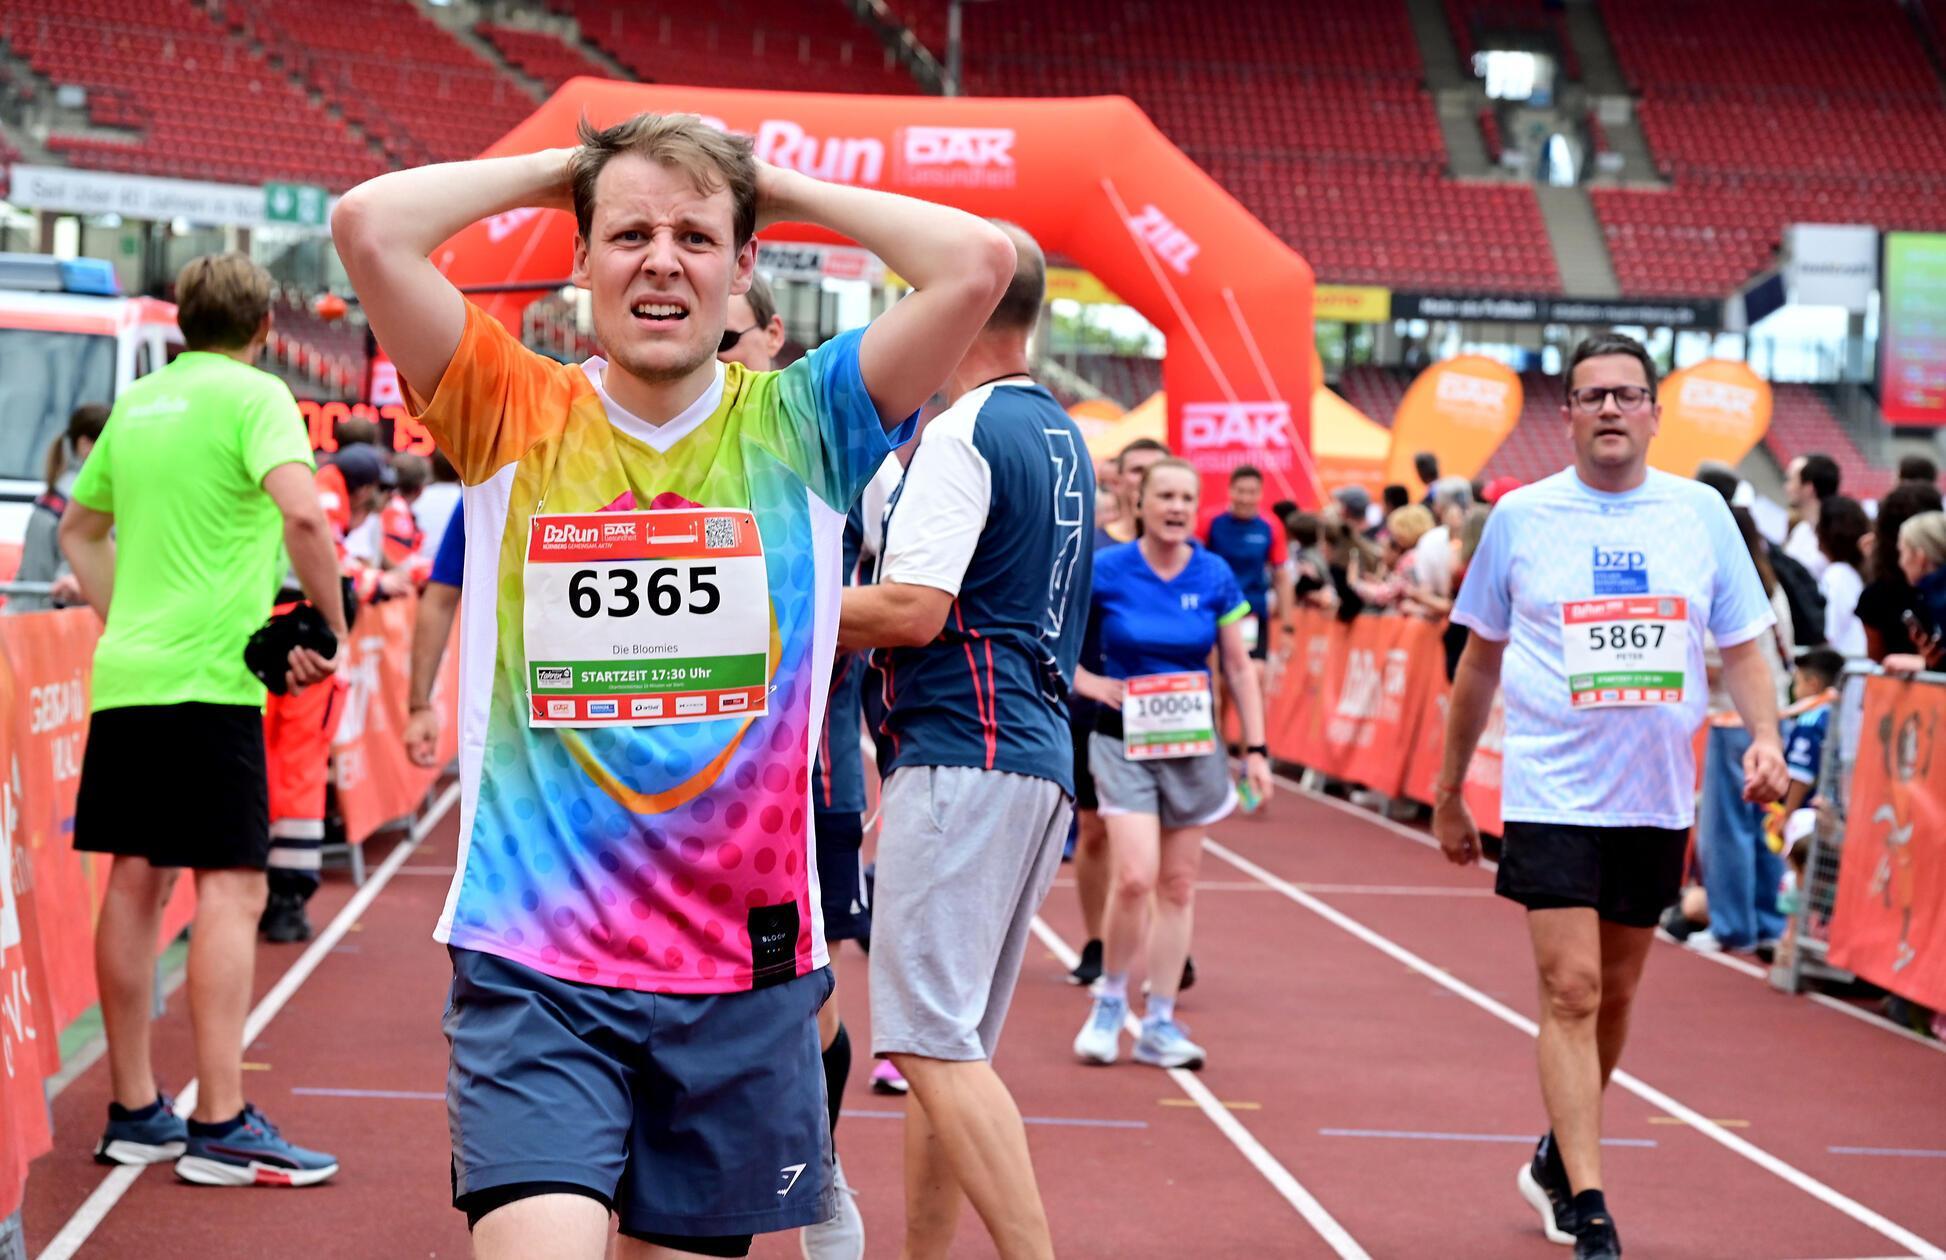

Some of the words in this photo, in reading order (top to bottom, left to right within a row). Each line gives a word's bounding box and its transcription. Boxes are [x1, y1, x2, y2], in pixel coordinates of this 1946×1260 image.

[699, 114, 885, 184] Run
[904, 126, 1015, 165] DAK
[1127, 204, 1199, 274] ZIEL
[1183, 402, 1289, 447] DAK
[543, 523, 600, 544] B2Run
[604, 522, 637, 535] DAK
[1593, 544, 1646, 571] bzp
[568, 565, 721, 618] 6365
[612, 644, 630, 655] Die
[632, 642, 679, 655] Bloomies
[1589, 624, 1666, 650] 5867
[581, 669, 648, 683] STARTZEIT
[651, 668, 686, 681] 17:30
[689, 666, 712, 679] Uhr
[1139, 695, 1203, 718] 10004
